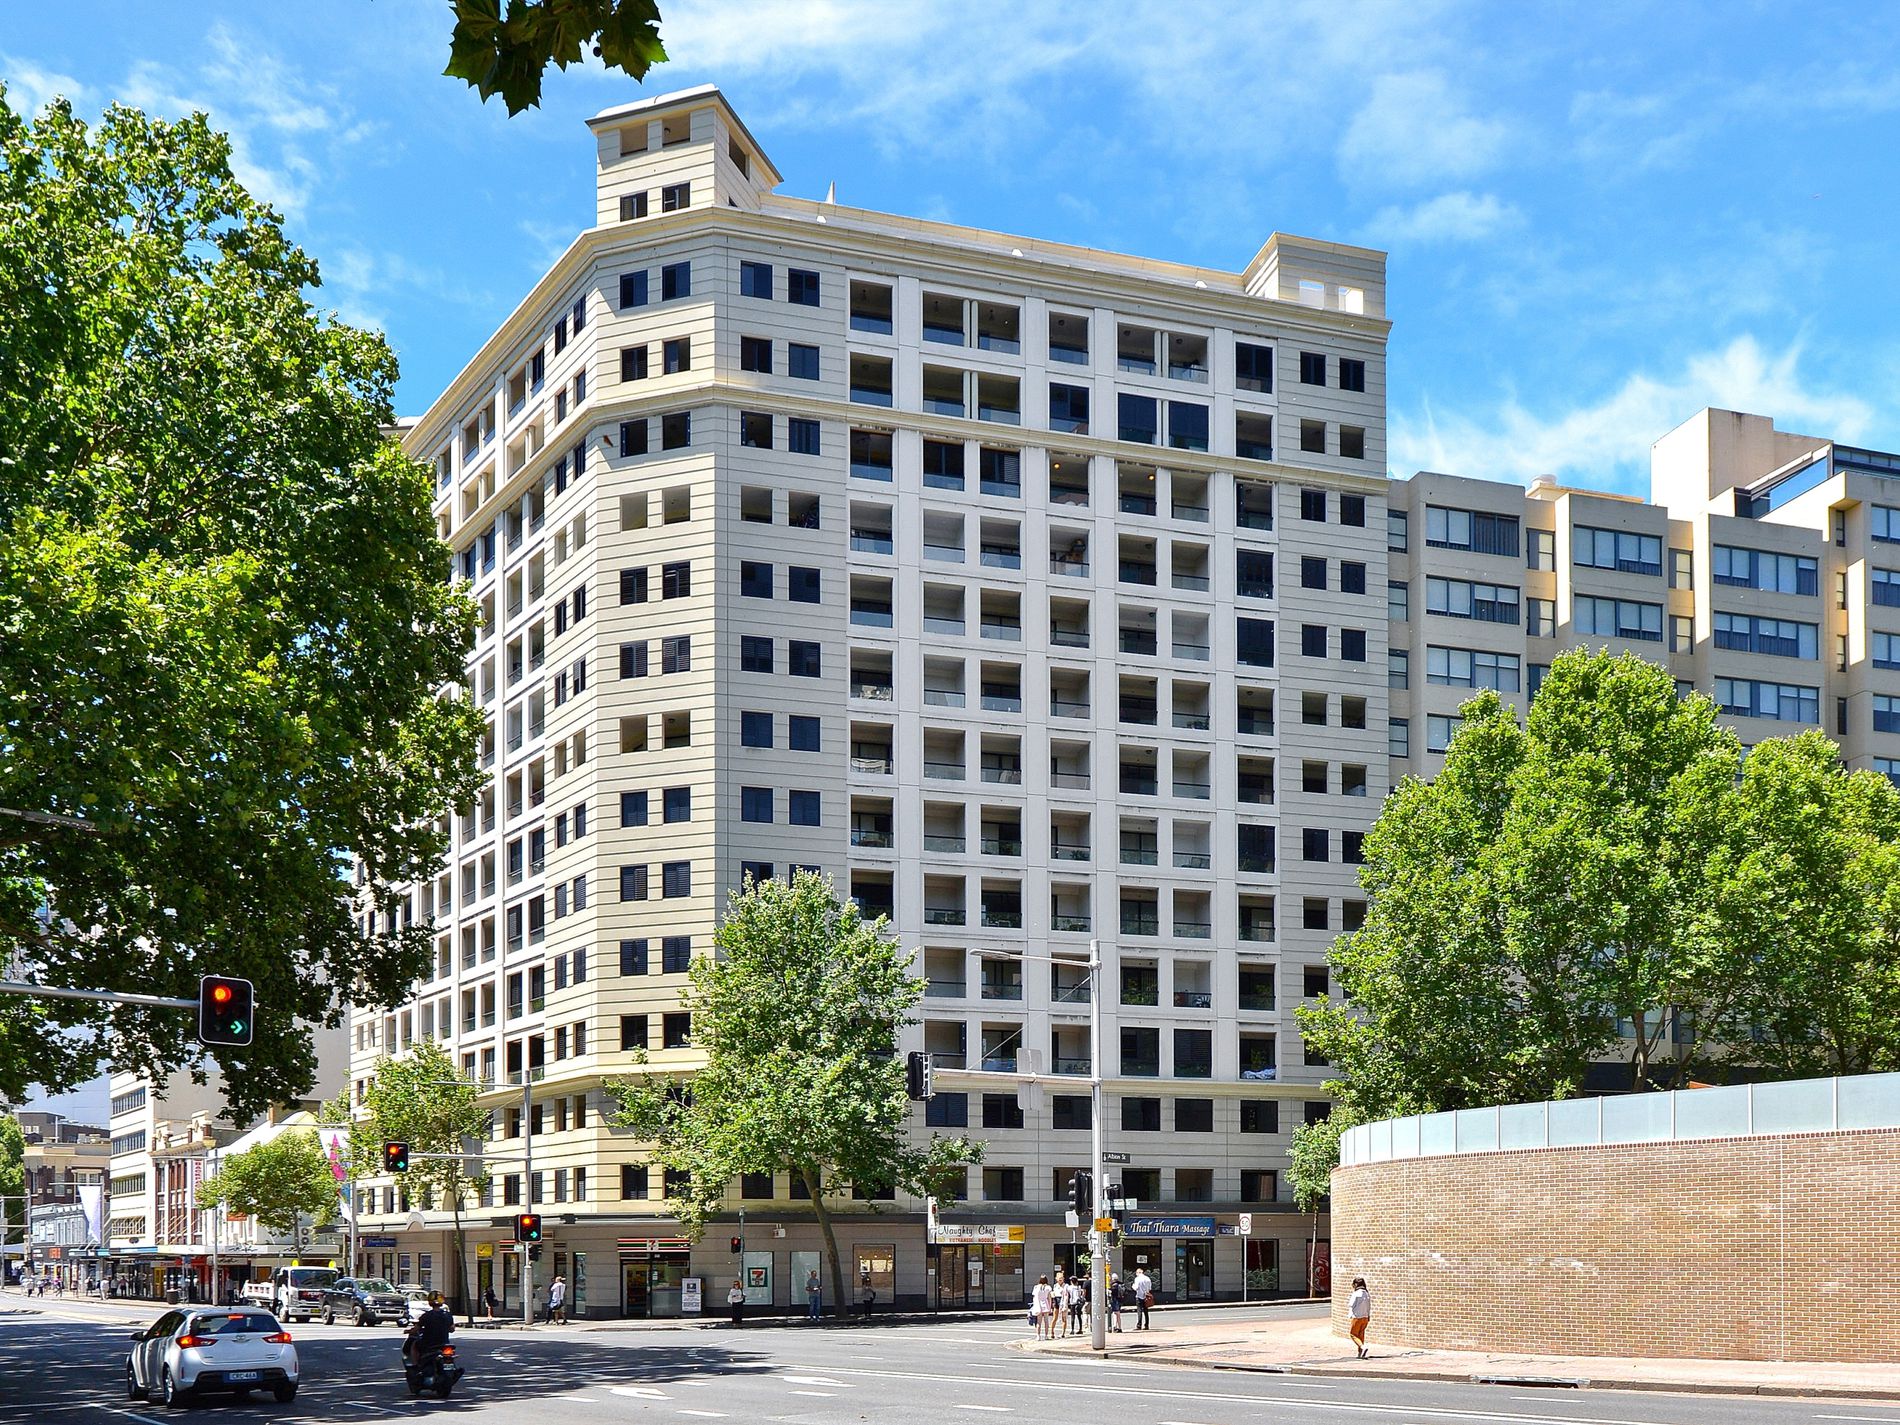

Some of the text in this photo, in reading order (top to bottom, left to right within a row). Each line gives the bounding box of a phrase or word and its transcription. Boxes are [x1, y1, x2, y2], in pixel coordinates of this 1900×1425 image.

[938, 1225, 973, 1237] Naughty
[978, 1224, 997, 1237] Chef
[1130, 1221, 1152, 1233] Thai
[1153, 1220, 1179, 1233] Thara
[1181, 1224, 1210, 1236] Massage
